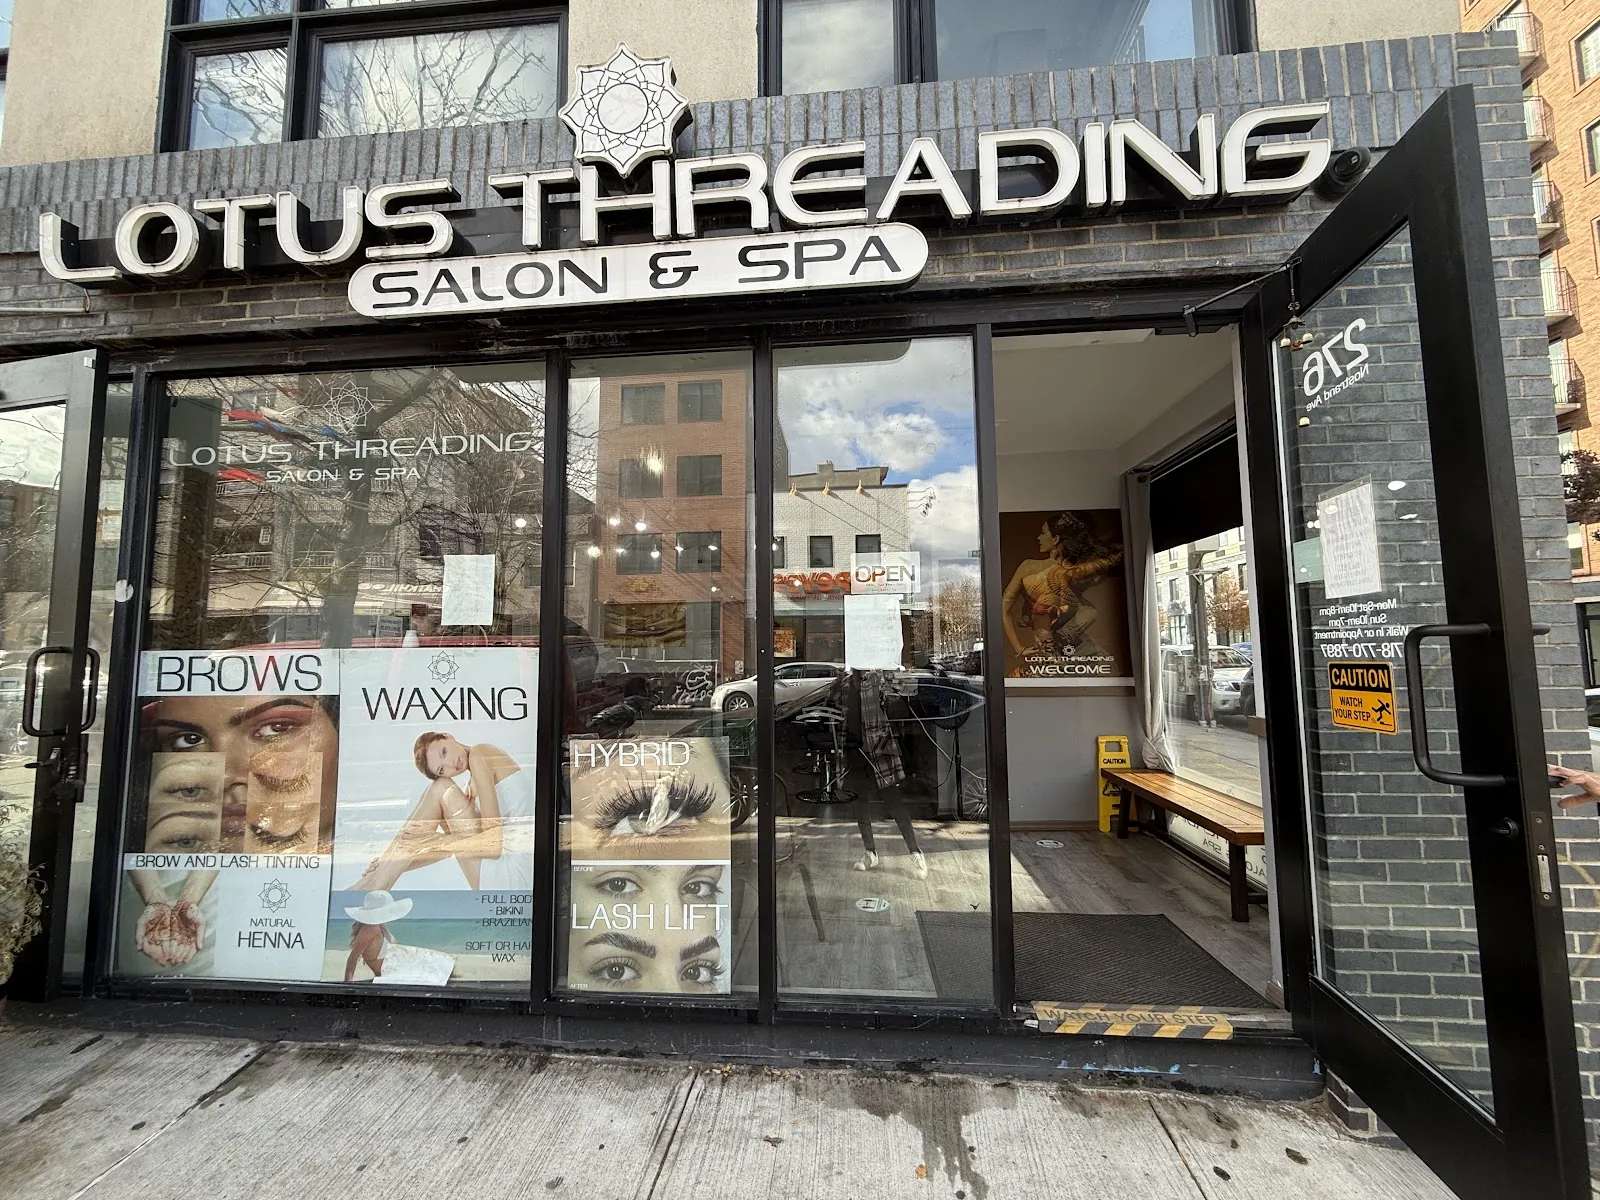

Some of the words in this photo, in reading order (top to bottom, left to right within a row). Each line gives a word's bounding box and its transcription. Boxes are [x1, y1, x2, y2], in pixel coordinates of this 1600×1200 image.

[39, 178, 460, 282] LOTUS
[488, 101, 1331, 248] THREADING
[373, 257, 608, 309] SALON
[649, 250, 699, 289] &
[738, 235, 902, 284] SPA
[169, 443, 292, 467] LOTUS
[309, 431, 535, 461] THREADING
[266, 469, 339, 483] SALON
[349, 469, 365, 482] &
[374, 467, 421, 481] SPA
[855, 565, 916, 583] OPEN
[156, 654, 322, 692] BROWS
[1029, 665, 1111, 674] WELCOME
[1331, 667, 1390, 689] CAUTION
[361, 686, 528, 721] WAXING
[1339, 695, 1363, 708] WATCH
[1334, 707, 1353, 719] YOUR
[1353, 710, 1371, 722] STEP
[573, 741, 691, 768] HYBRID
[135, 855, 181, 868] BROW
[184, 855, 217, 868] AND
[220, 855, 259, 868] LASH
[264, 855, 320, 869] TINTING
[482, 894, 507, 904] FULL
[510, 894, 533, 904] BOD
[496, 906, 524, 915] BIKINI
[571, 903, 654, 930] LASH
[664, 903, 729, 931] LIFT
[249, 918, 296, 928] NATURAL
[237, 931, 305, 949] HENNA
[465, 941, 493, 951] SOFT
[495, 941, 511, 951] OR
[491, 953, 516, 963] WAX
[1043, 1009, 1110, 1022] WATCH
[1114, 1012, 1170, 1025] YOUR
[1171, 1013, 1219, 1026] STEP
